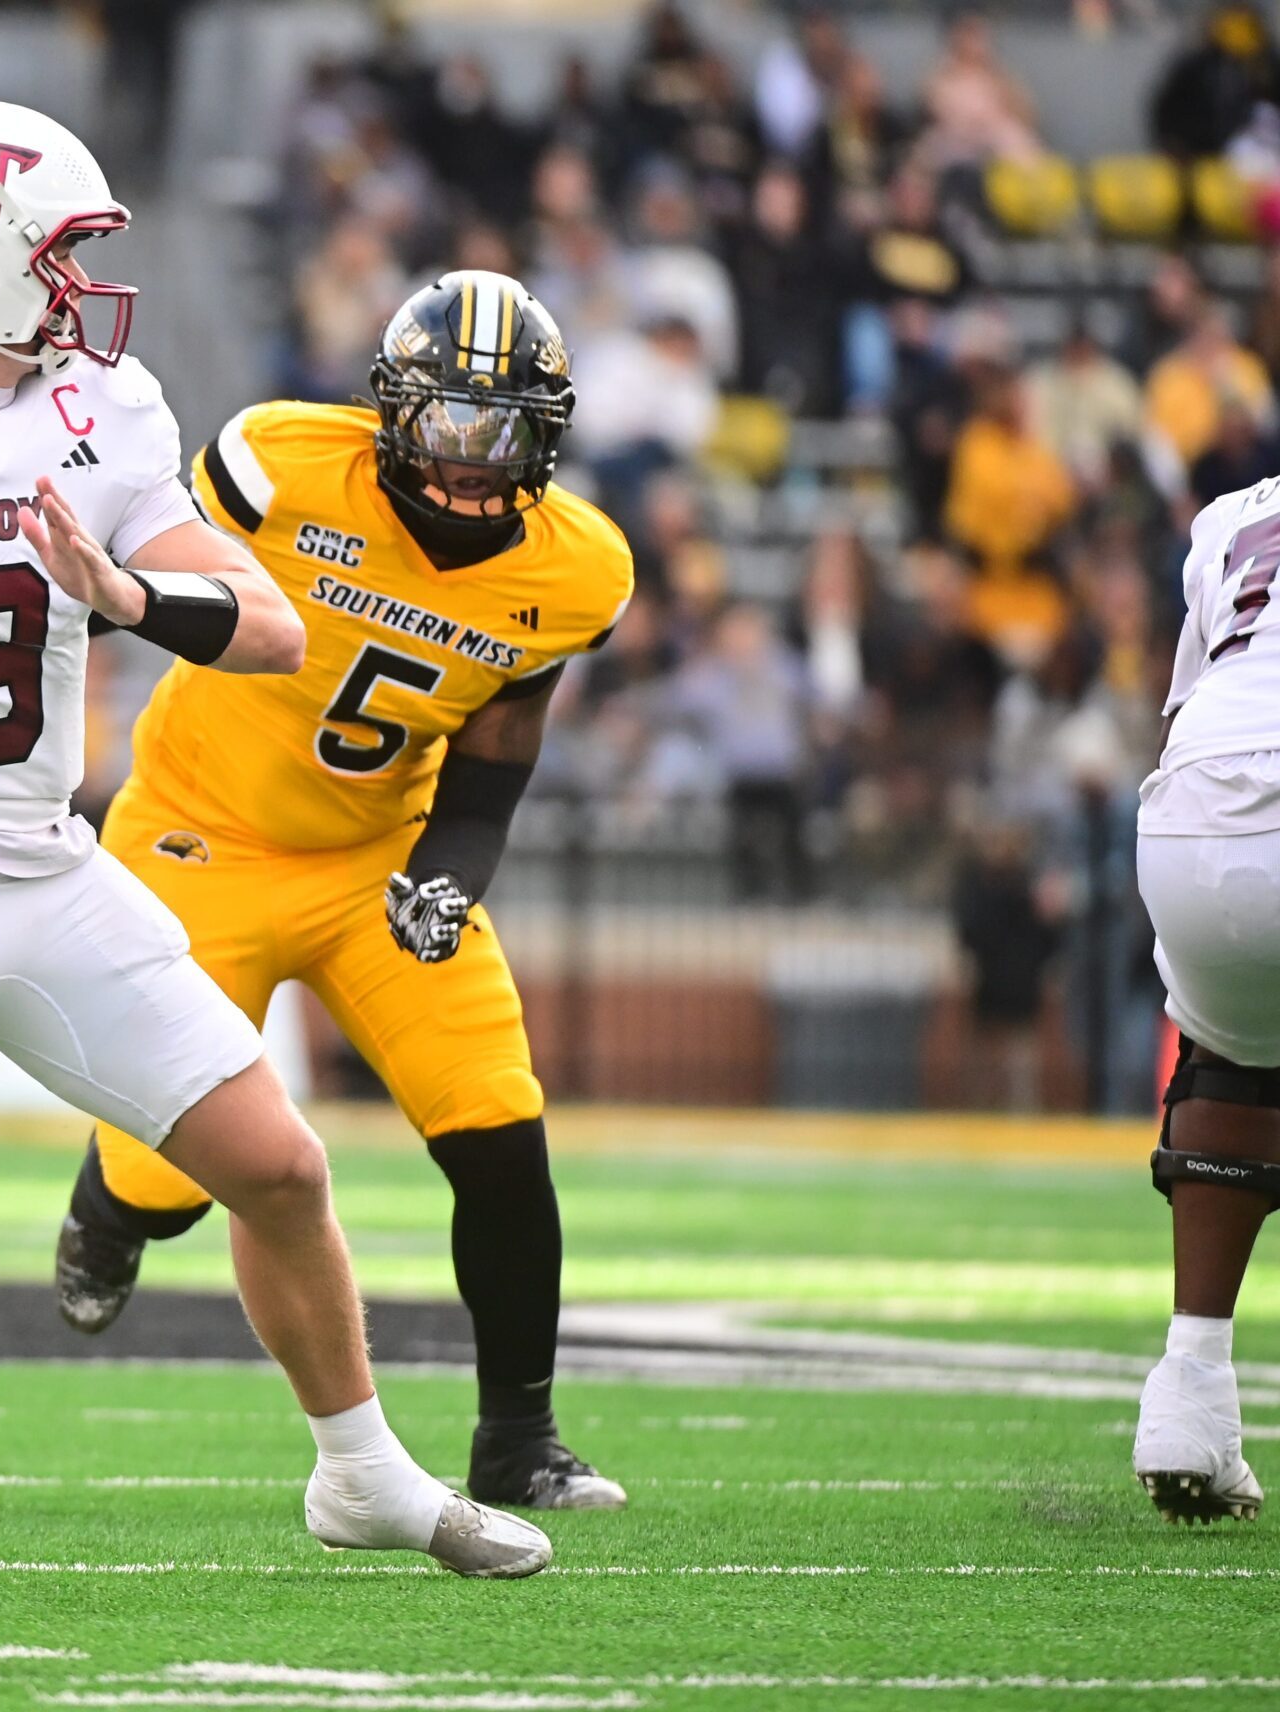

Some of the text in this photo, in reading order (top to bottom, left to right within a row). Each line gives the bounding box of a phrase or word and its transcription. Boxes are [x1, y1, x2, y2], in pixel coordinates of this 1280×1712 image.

[50, 382, 95, 437] C
[295, 521, 366, 568] SBC
[309, 575, 525, 669] SOUTHERN MISS
[314, 639, 446, 775] 5
[1186, 1159, 1250, 1178] DONJOY
